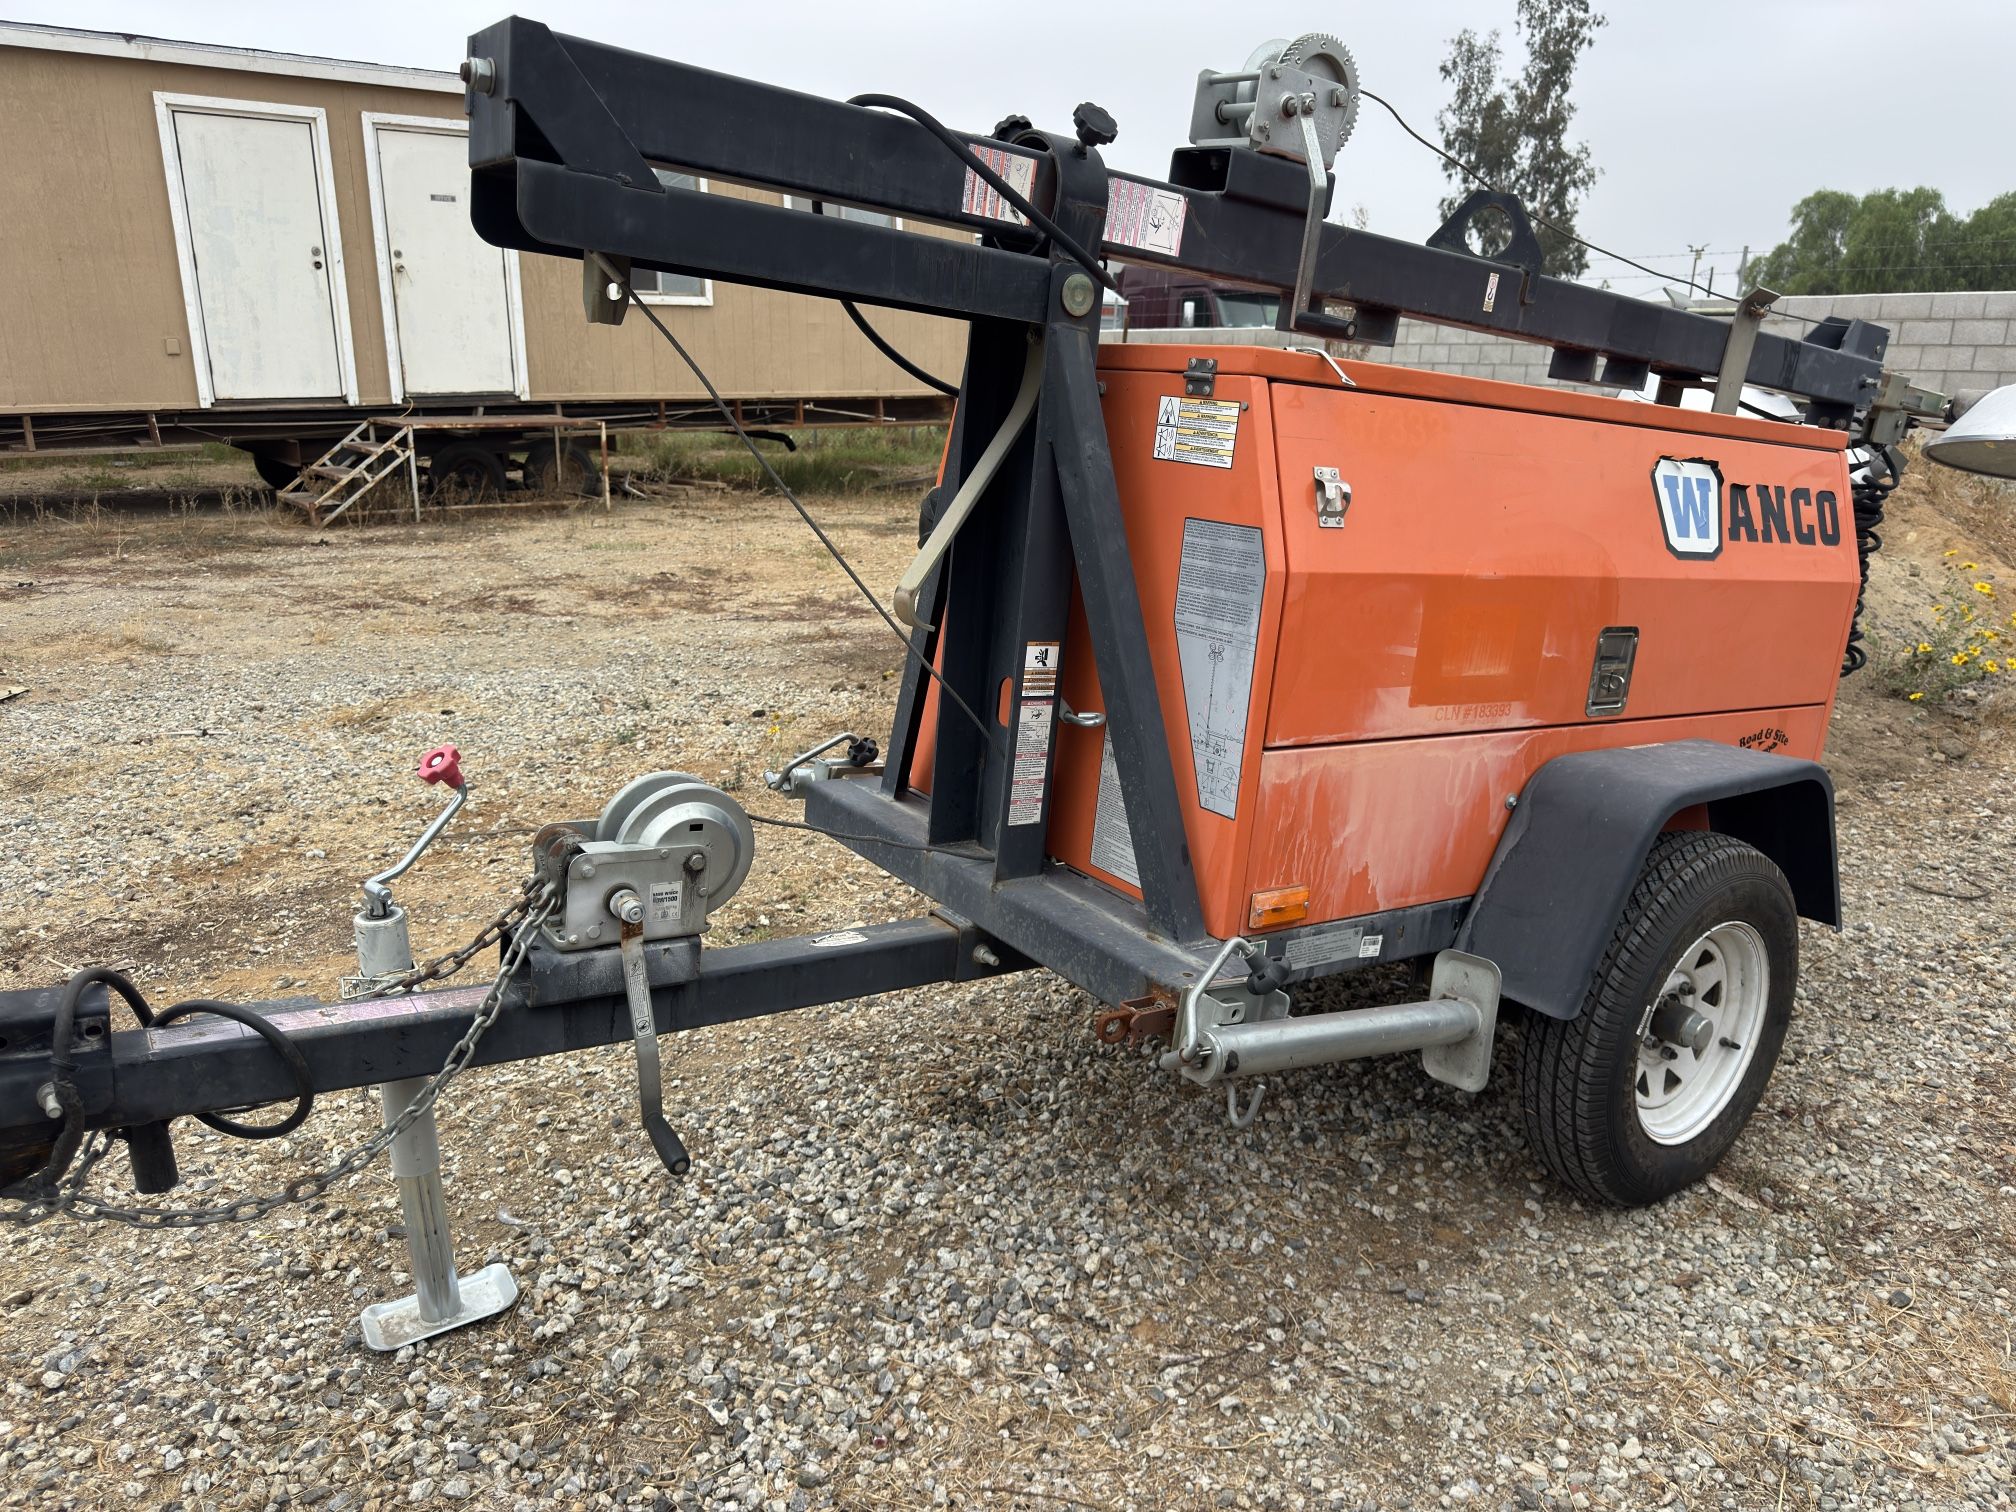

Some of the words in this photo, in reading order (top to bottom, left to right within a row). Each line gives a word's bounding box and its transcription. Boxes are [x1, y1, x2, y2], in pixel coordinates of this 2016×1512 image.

[1662, 474, 1841, 547] WANCO
[1435, 707, 1461, 721] CLN
[1463, 703, 1512, 719] #183393
[1739, 729, 1763, 747] Road
[1764, 728, 1773, 739] &
[1773, 729, 1789, 746] Site
